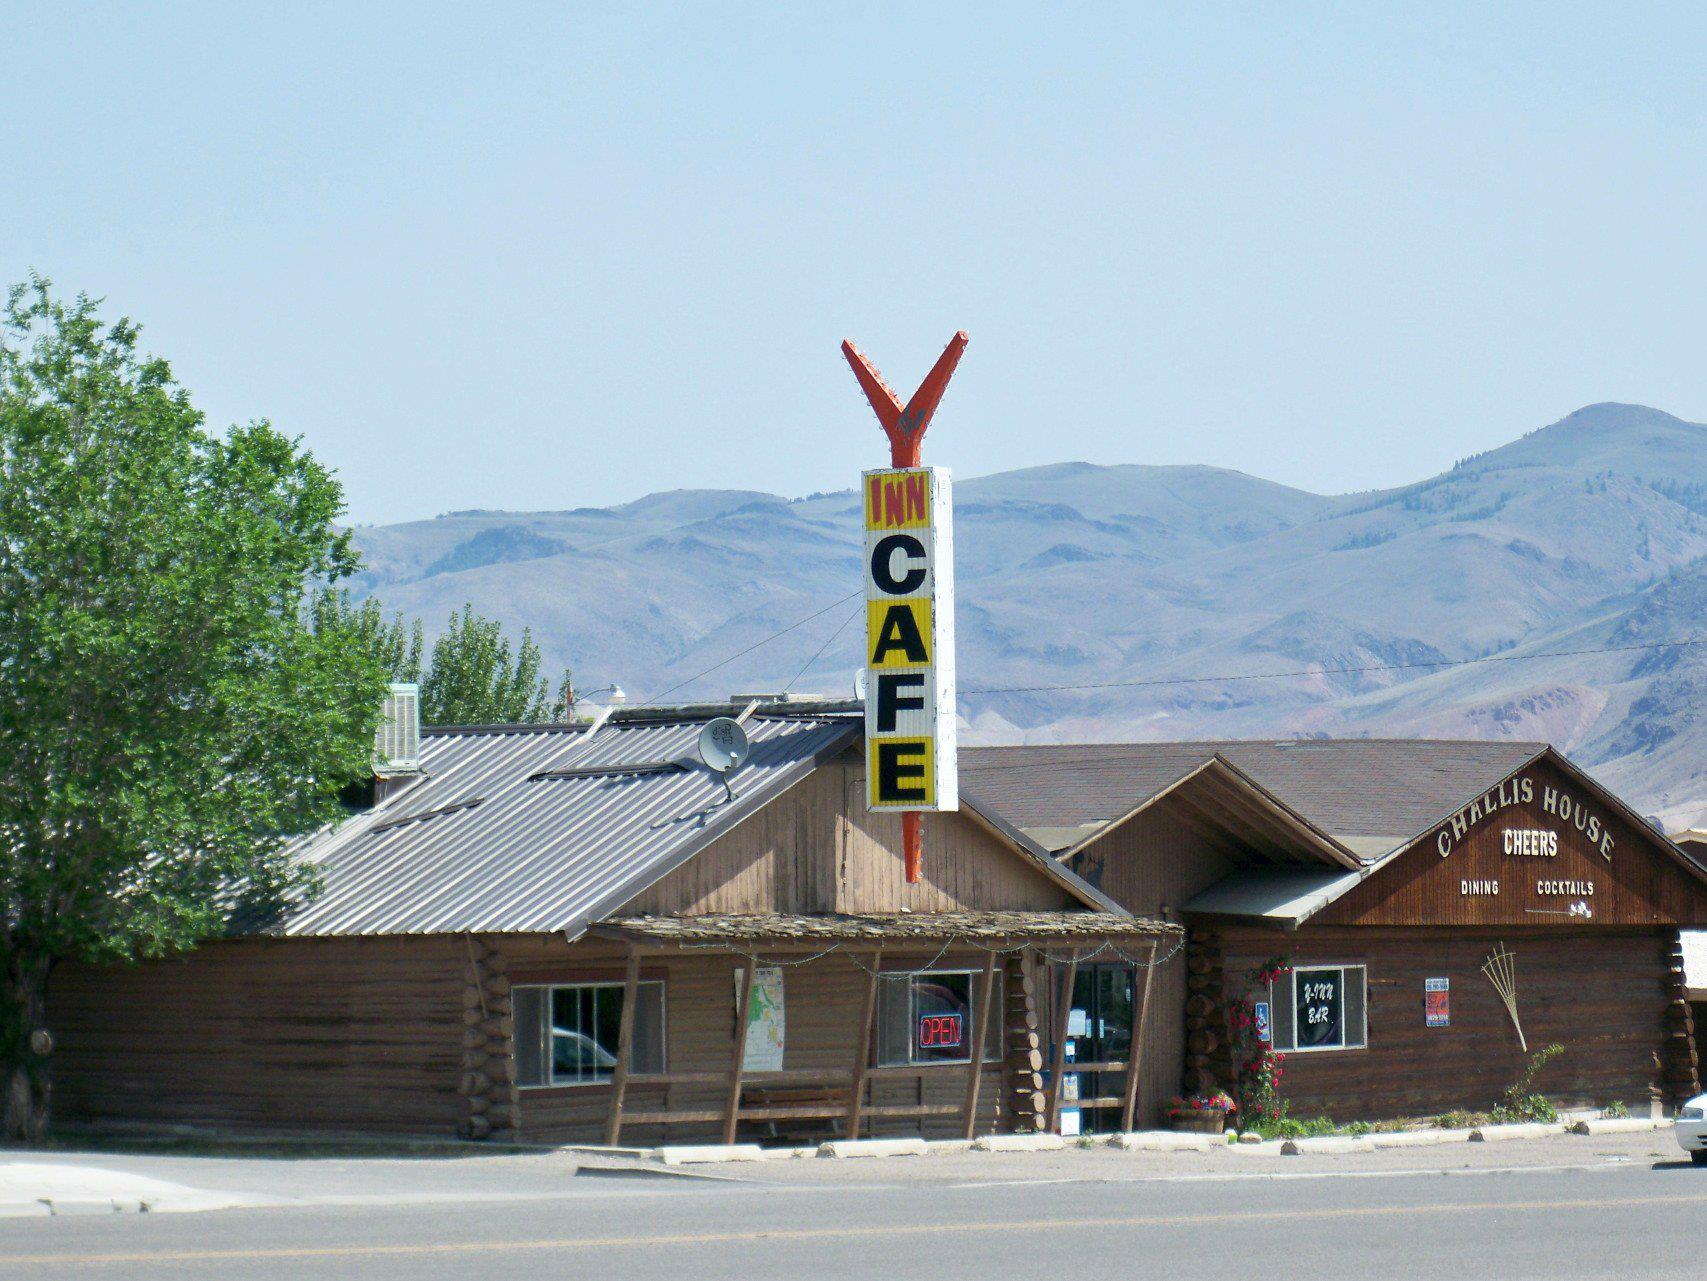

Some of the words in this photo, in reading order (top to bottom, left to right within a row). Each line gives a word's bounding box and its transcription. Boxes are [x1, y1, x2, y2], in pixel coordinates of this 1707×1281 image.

[871, 475, 926, 527] INN
[870, 534, 929, 801] CAFE
[1438, 777, 1534, 858] CHALLIS
[1543, 785, 1615, 863] HOUSE
[1504, 829, 1558, 857] CHEERS
[1461, 880, 1499, 895] DINING
[1537, 880, 1594, 895] COCKTAILS
[1308, 1006, 1329, 1024] BAR
[922, 1017, 960, 1045] OPEN
